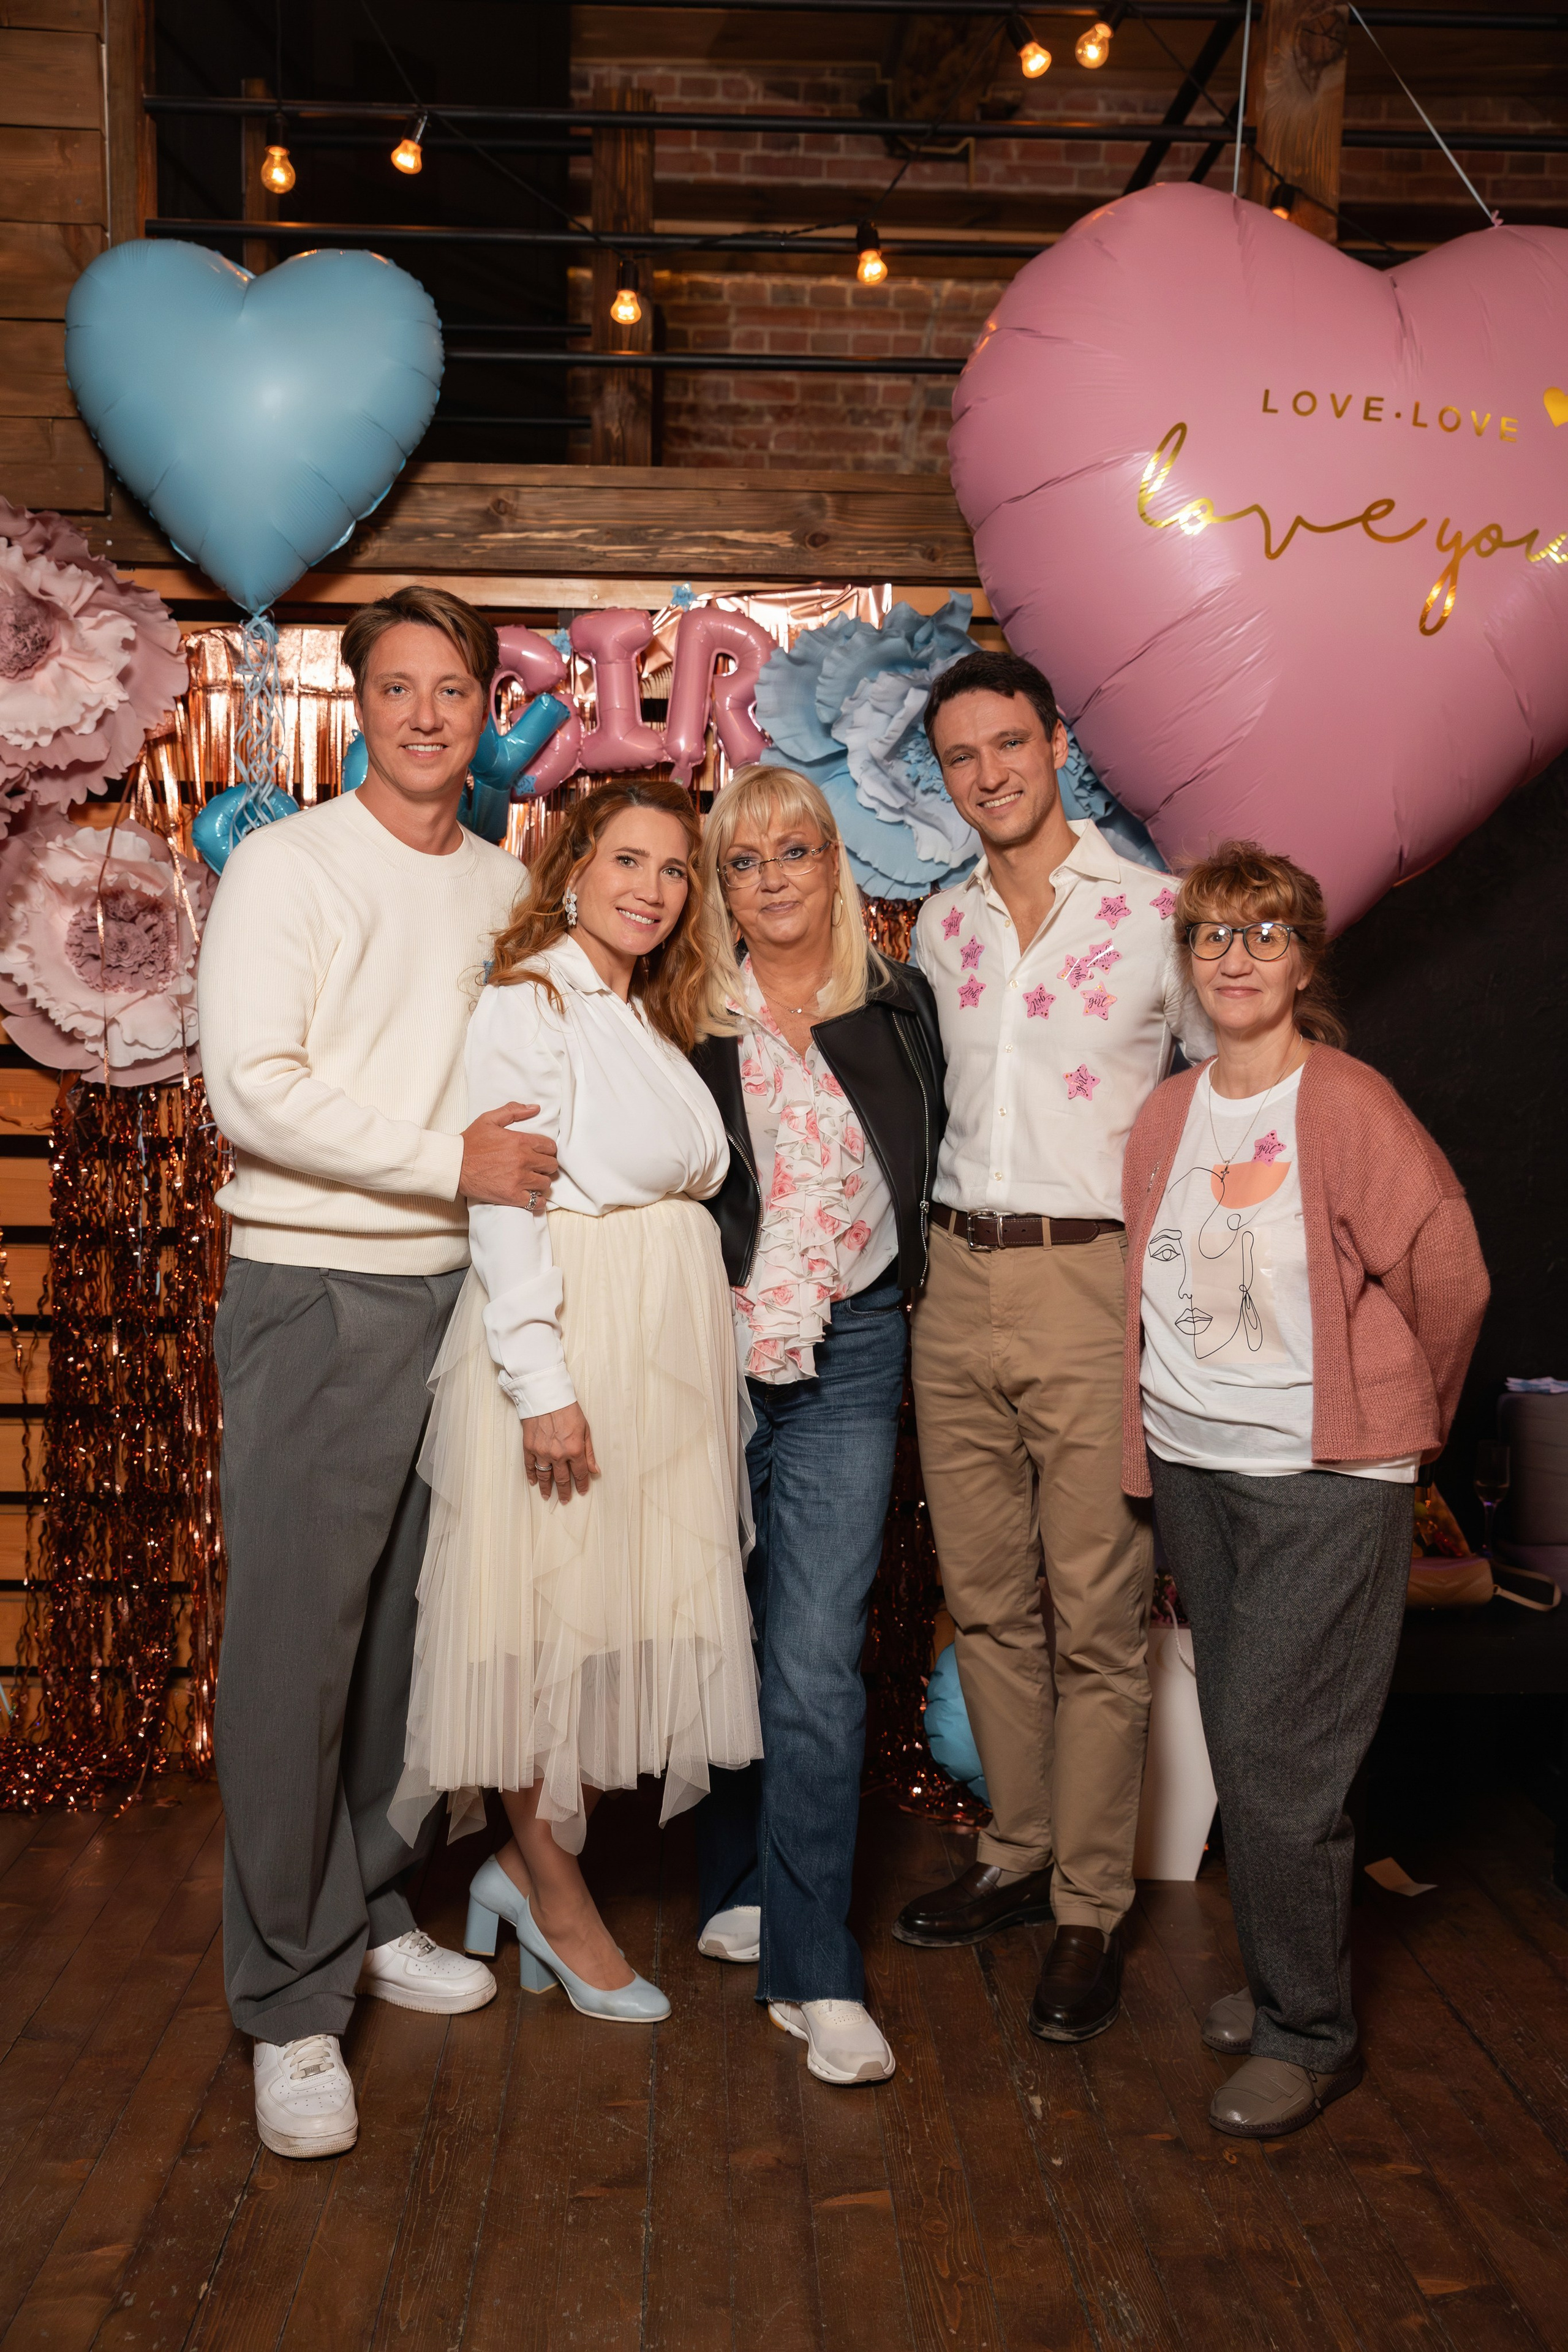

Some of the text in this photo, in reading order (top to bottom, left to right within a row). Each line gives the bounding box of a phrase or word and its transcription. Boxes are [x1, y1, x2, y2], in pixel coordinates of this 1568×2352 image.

[1137, 422, 1428, 560] love
[1102, 903, 1126, 916] girl
[962, 948, 981, 962] girl
[1085, 997, 1111, 1009] girl
[1075, 1069, 1088, 1095] girl
[1256, 1144, 1281, 1156] girl
